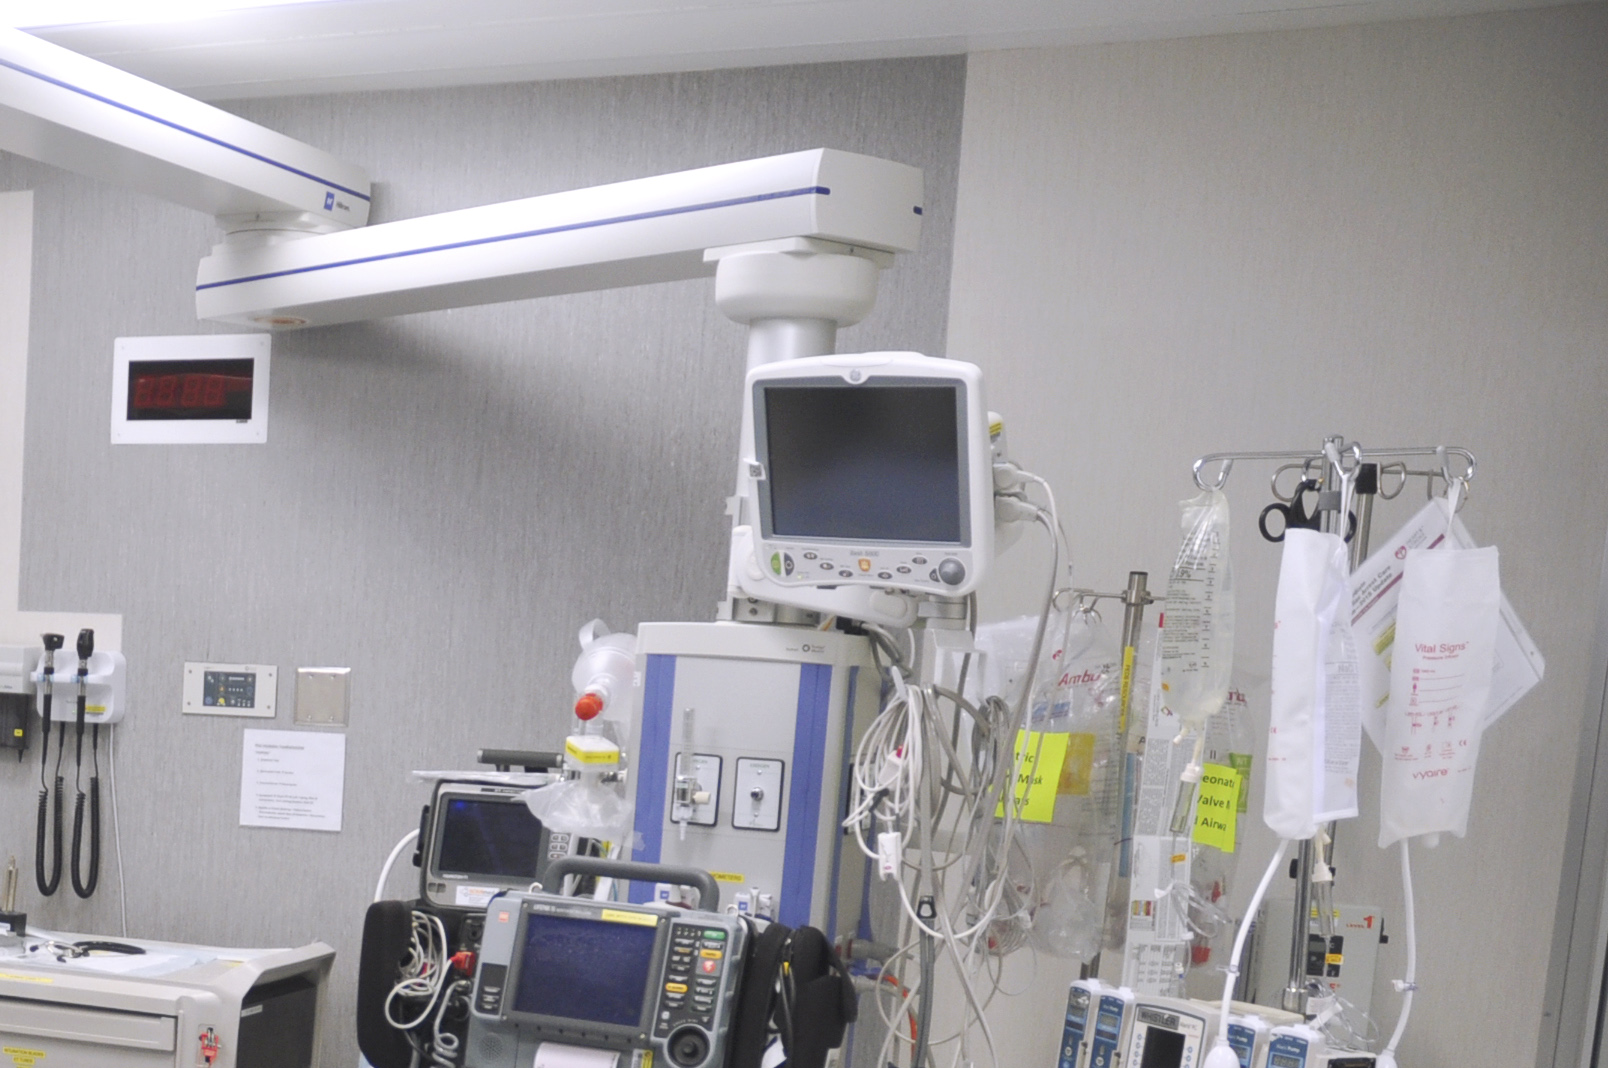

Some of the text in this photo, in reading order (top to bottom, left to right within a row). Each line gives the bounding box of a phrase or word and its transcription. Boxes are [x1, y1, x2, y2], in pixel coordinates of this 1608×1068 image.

[1414, 642, 1466, 653] Vital Signs
[1058, 669, 1101, 686] Ambu
[1412, 768, 1448, 780] vyaire
[1363, 915, 1373, 929] 1
[1141, 1011, 1176, 1026] WHISTLER
